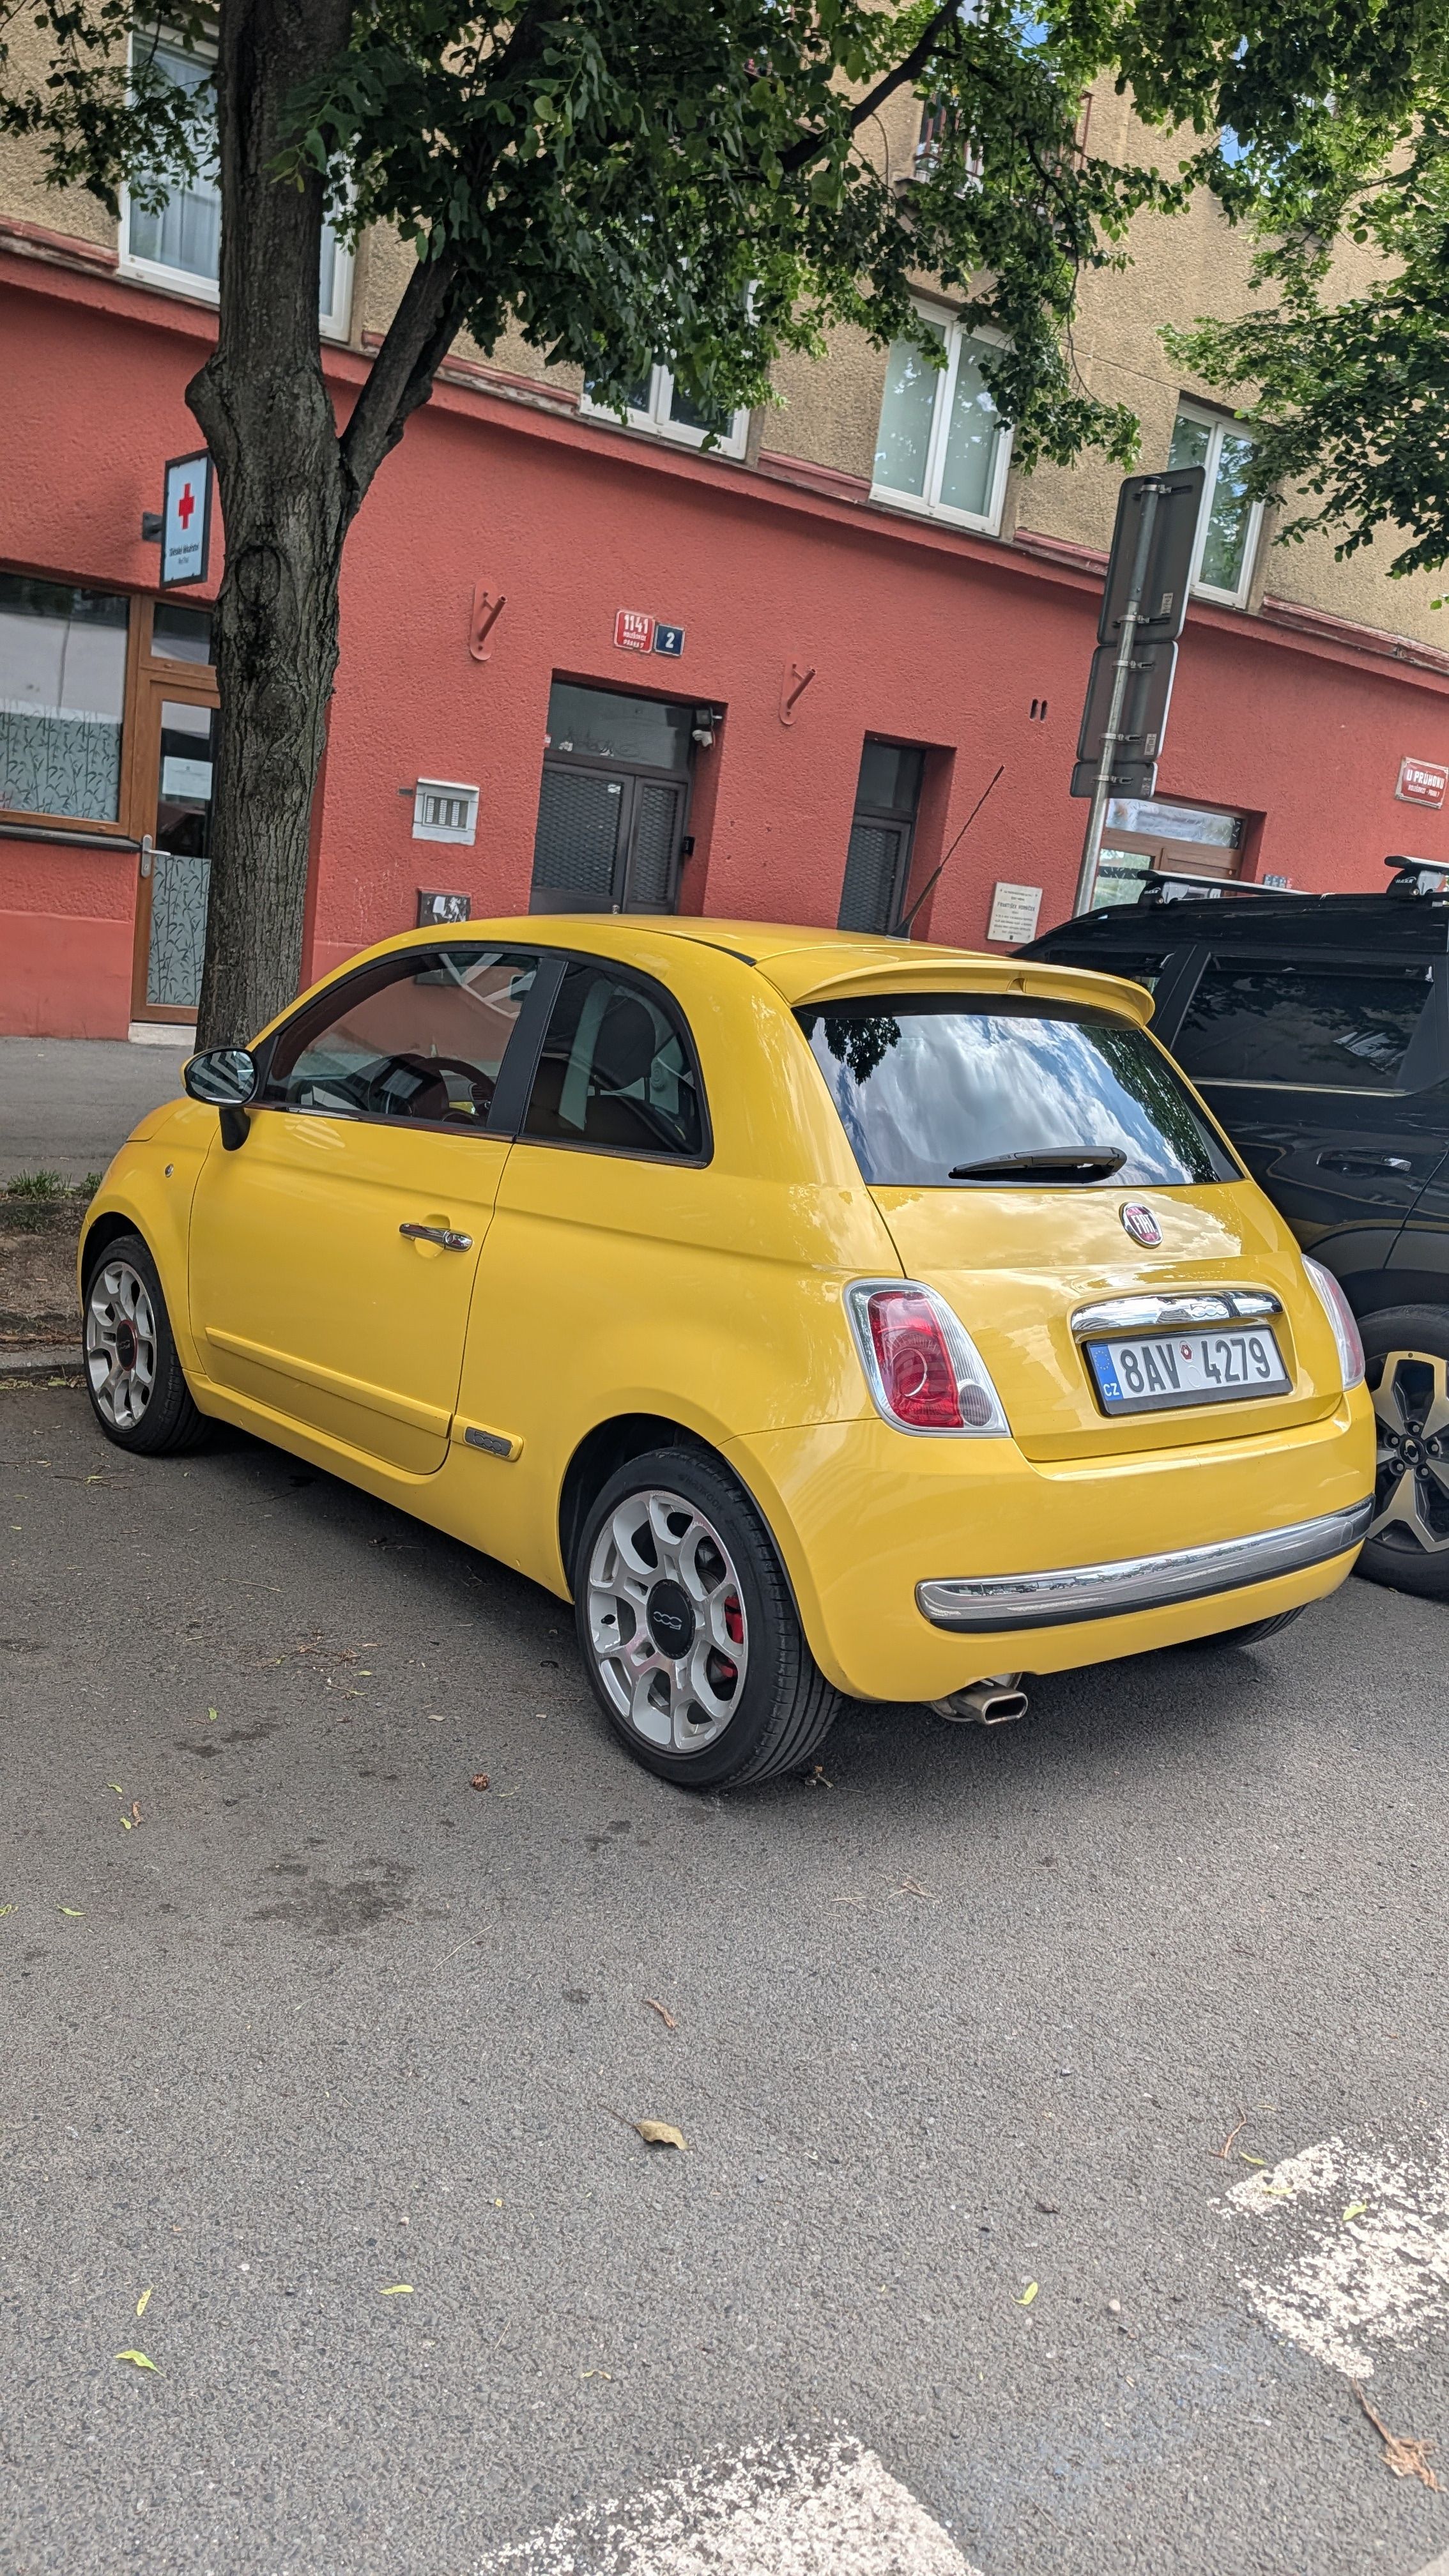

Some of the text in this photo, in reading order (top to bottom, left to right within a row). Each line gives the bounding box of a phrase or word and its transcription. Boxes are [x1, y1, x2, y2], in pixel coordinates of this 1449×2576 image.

[624, 614, 648, 634] 1141
[665, 632, 675, 648] 2
[1406, 769, 1445, 790] U PRŮHONU
[1130, 1214, 1155, 1234] FIAT
[1190, 1303, 1227, 1318] 500
[1120, 1337, 1271, 1393] 8AV 4279
[1103, 1383, 1120, 1397] CZ
[473, 1431, 502, 1452] 500
[653, 1611, 682, 1630] 500
